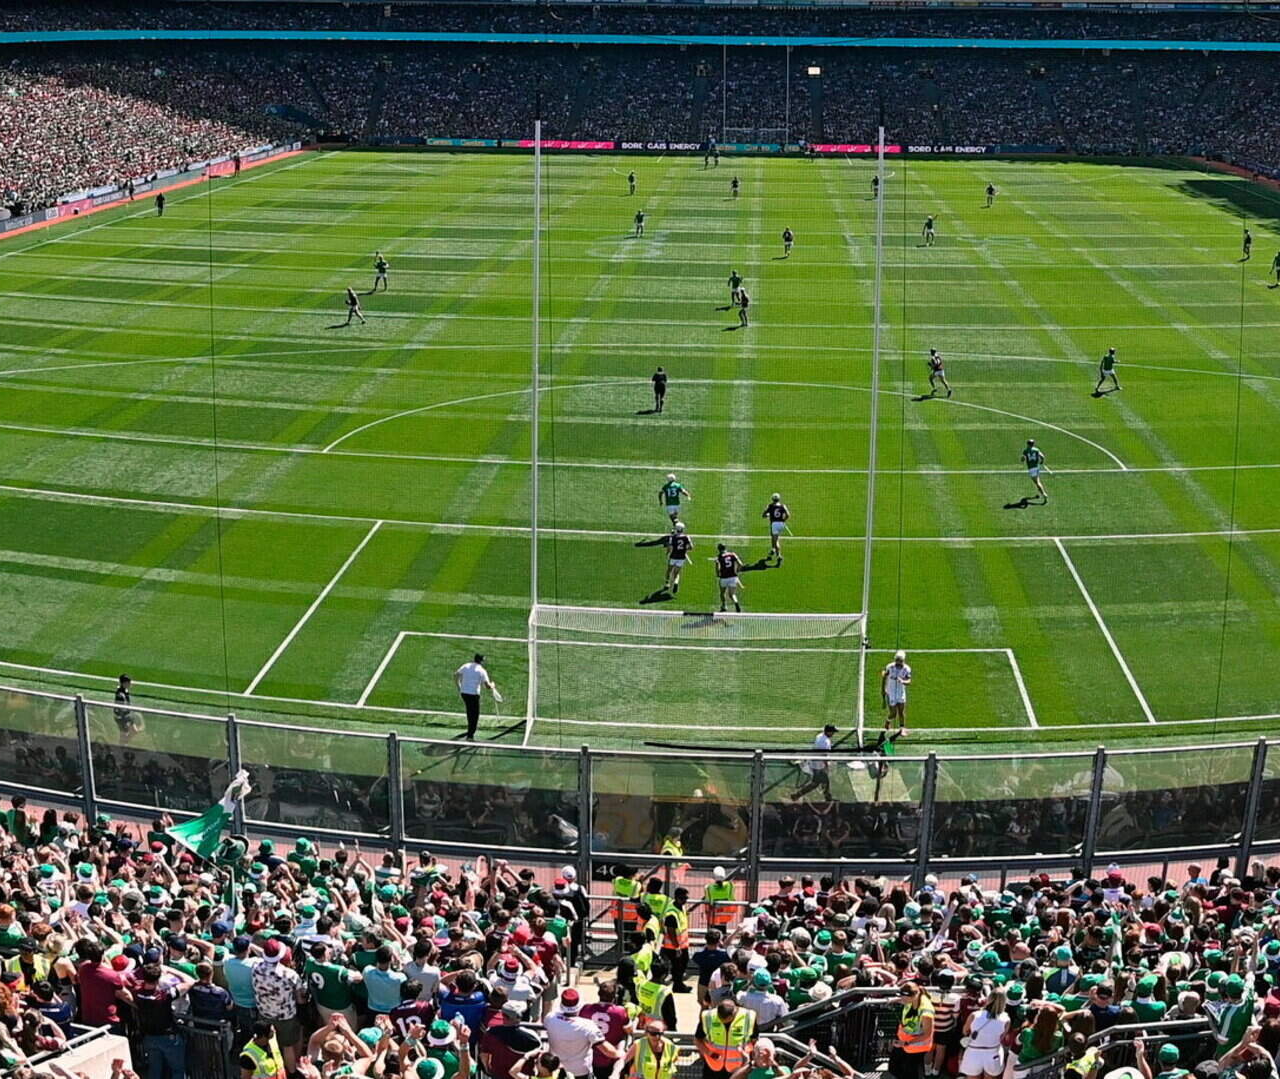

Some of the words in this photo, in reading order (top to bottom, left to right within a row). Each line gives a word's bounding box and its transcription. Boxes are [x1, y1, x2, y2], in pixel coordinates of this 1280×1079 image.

[669, 143, 701, 151] ENERGY
[954, 146, 987, 154] ENERGY
[667, 488, 678, 497] 13
[774, 508, 781, 518] 6
[677, 540, 685, 550] 2
[725, 556, 732, 568] 5
[311, 972, 325, 990] 9
